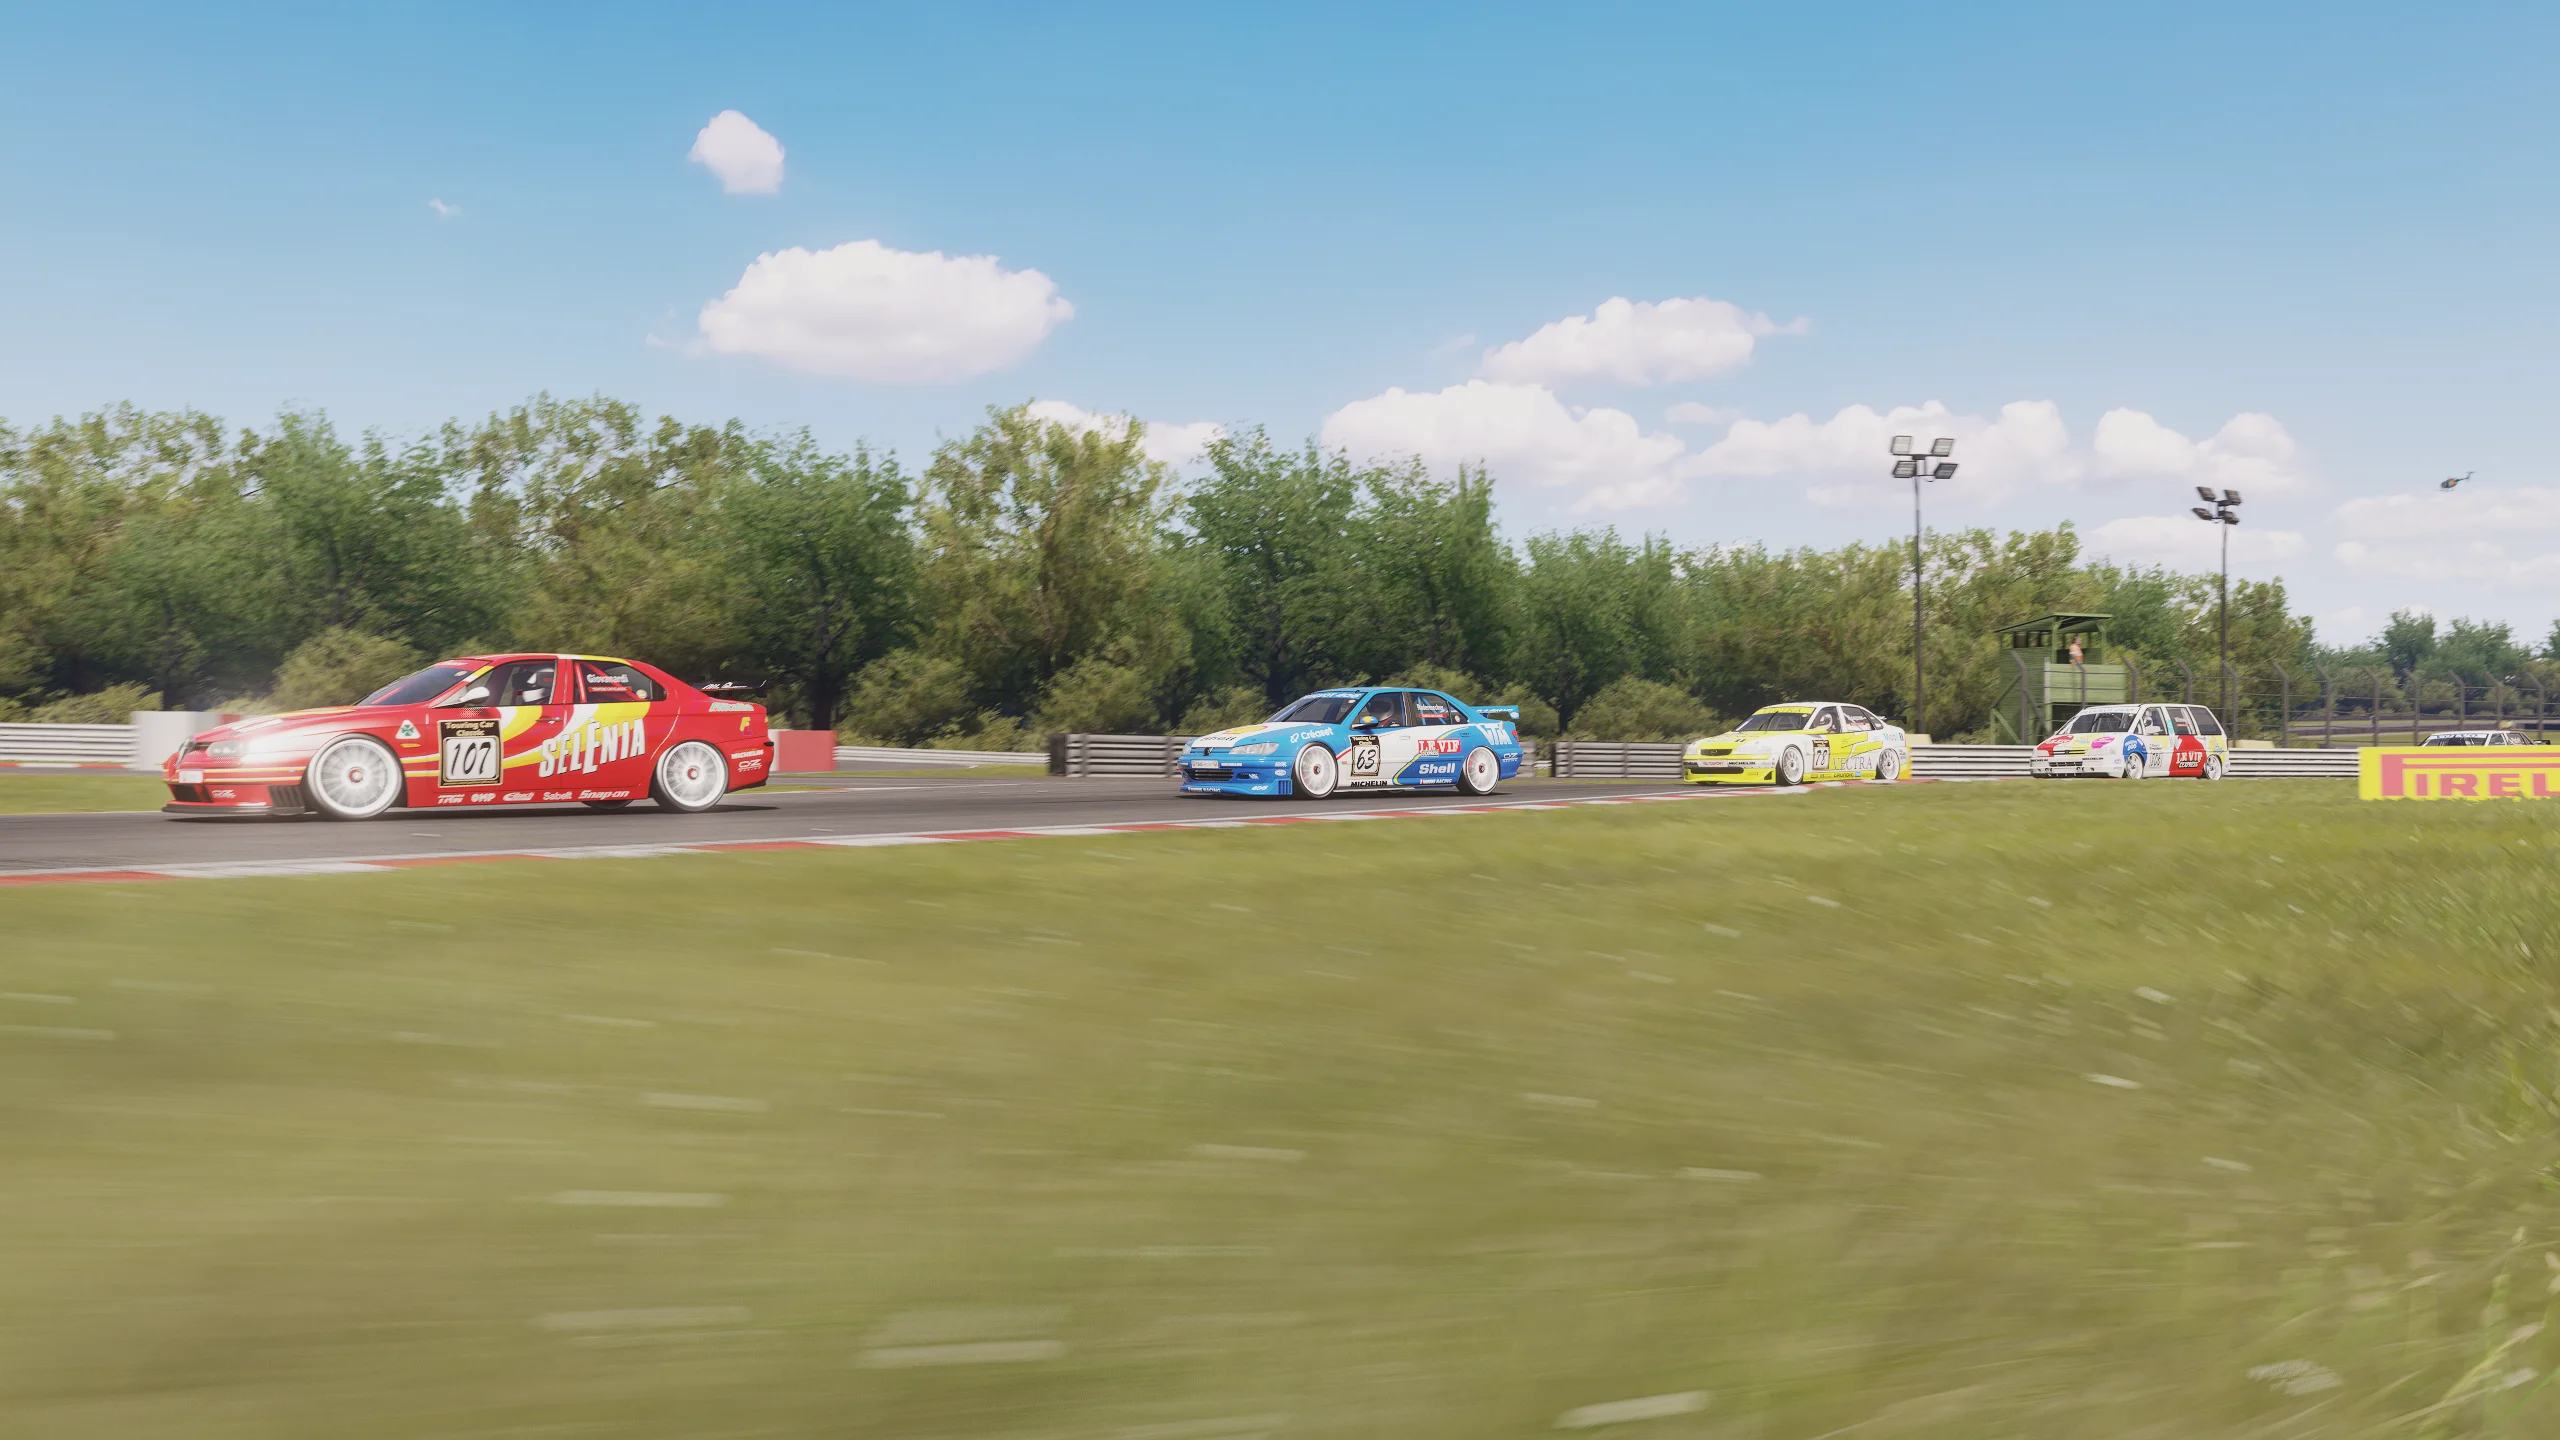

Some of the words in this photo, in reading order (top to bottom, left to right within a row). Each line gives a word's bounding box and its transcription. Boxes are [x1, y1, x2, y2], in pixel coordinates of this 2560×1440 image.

[445, 721, 479, 730] Touring
[1418, 740, 1436, 753] LE
[1437, 740, 1460, 753] VIF
[451, 741, 491, 776] 107
[731, 749, 764, 759] MICHELIN
[1357, 749, 1376, 770] 63
[1419, 763, 1456, 774] Shell
[1833, 757, 1873, 770] VECTRA
[578, 790, 630, 800] Snap-on
